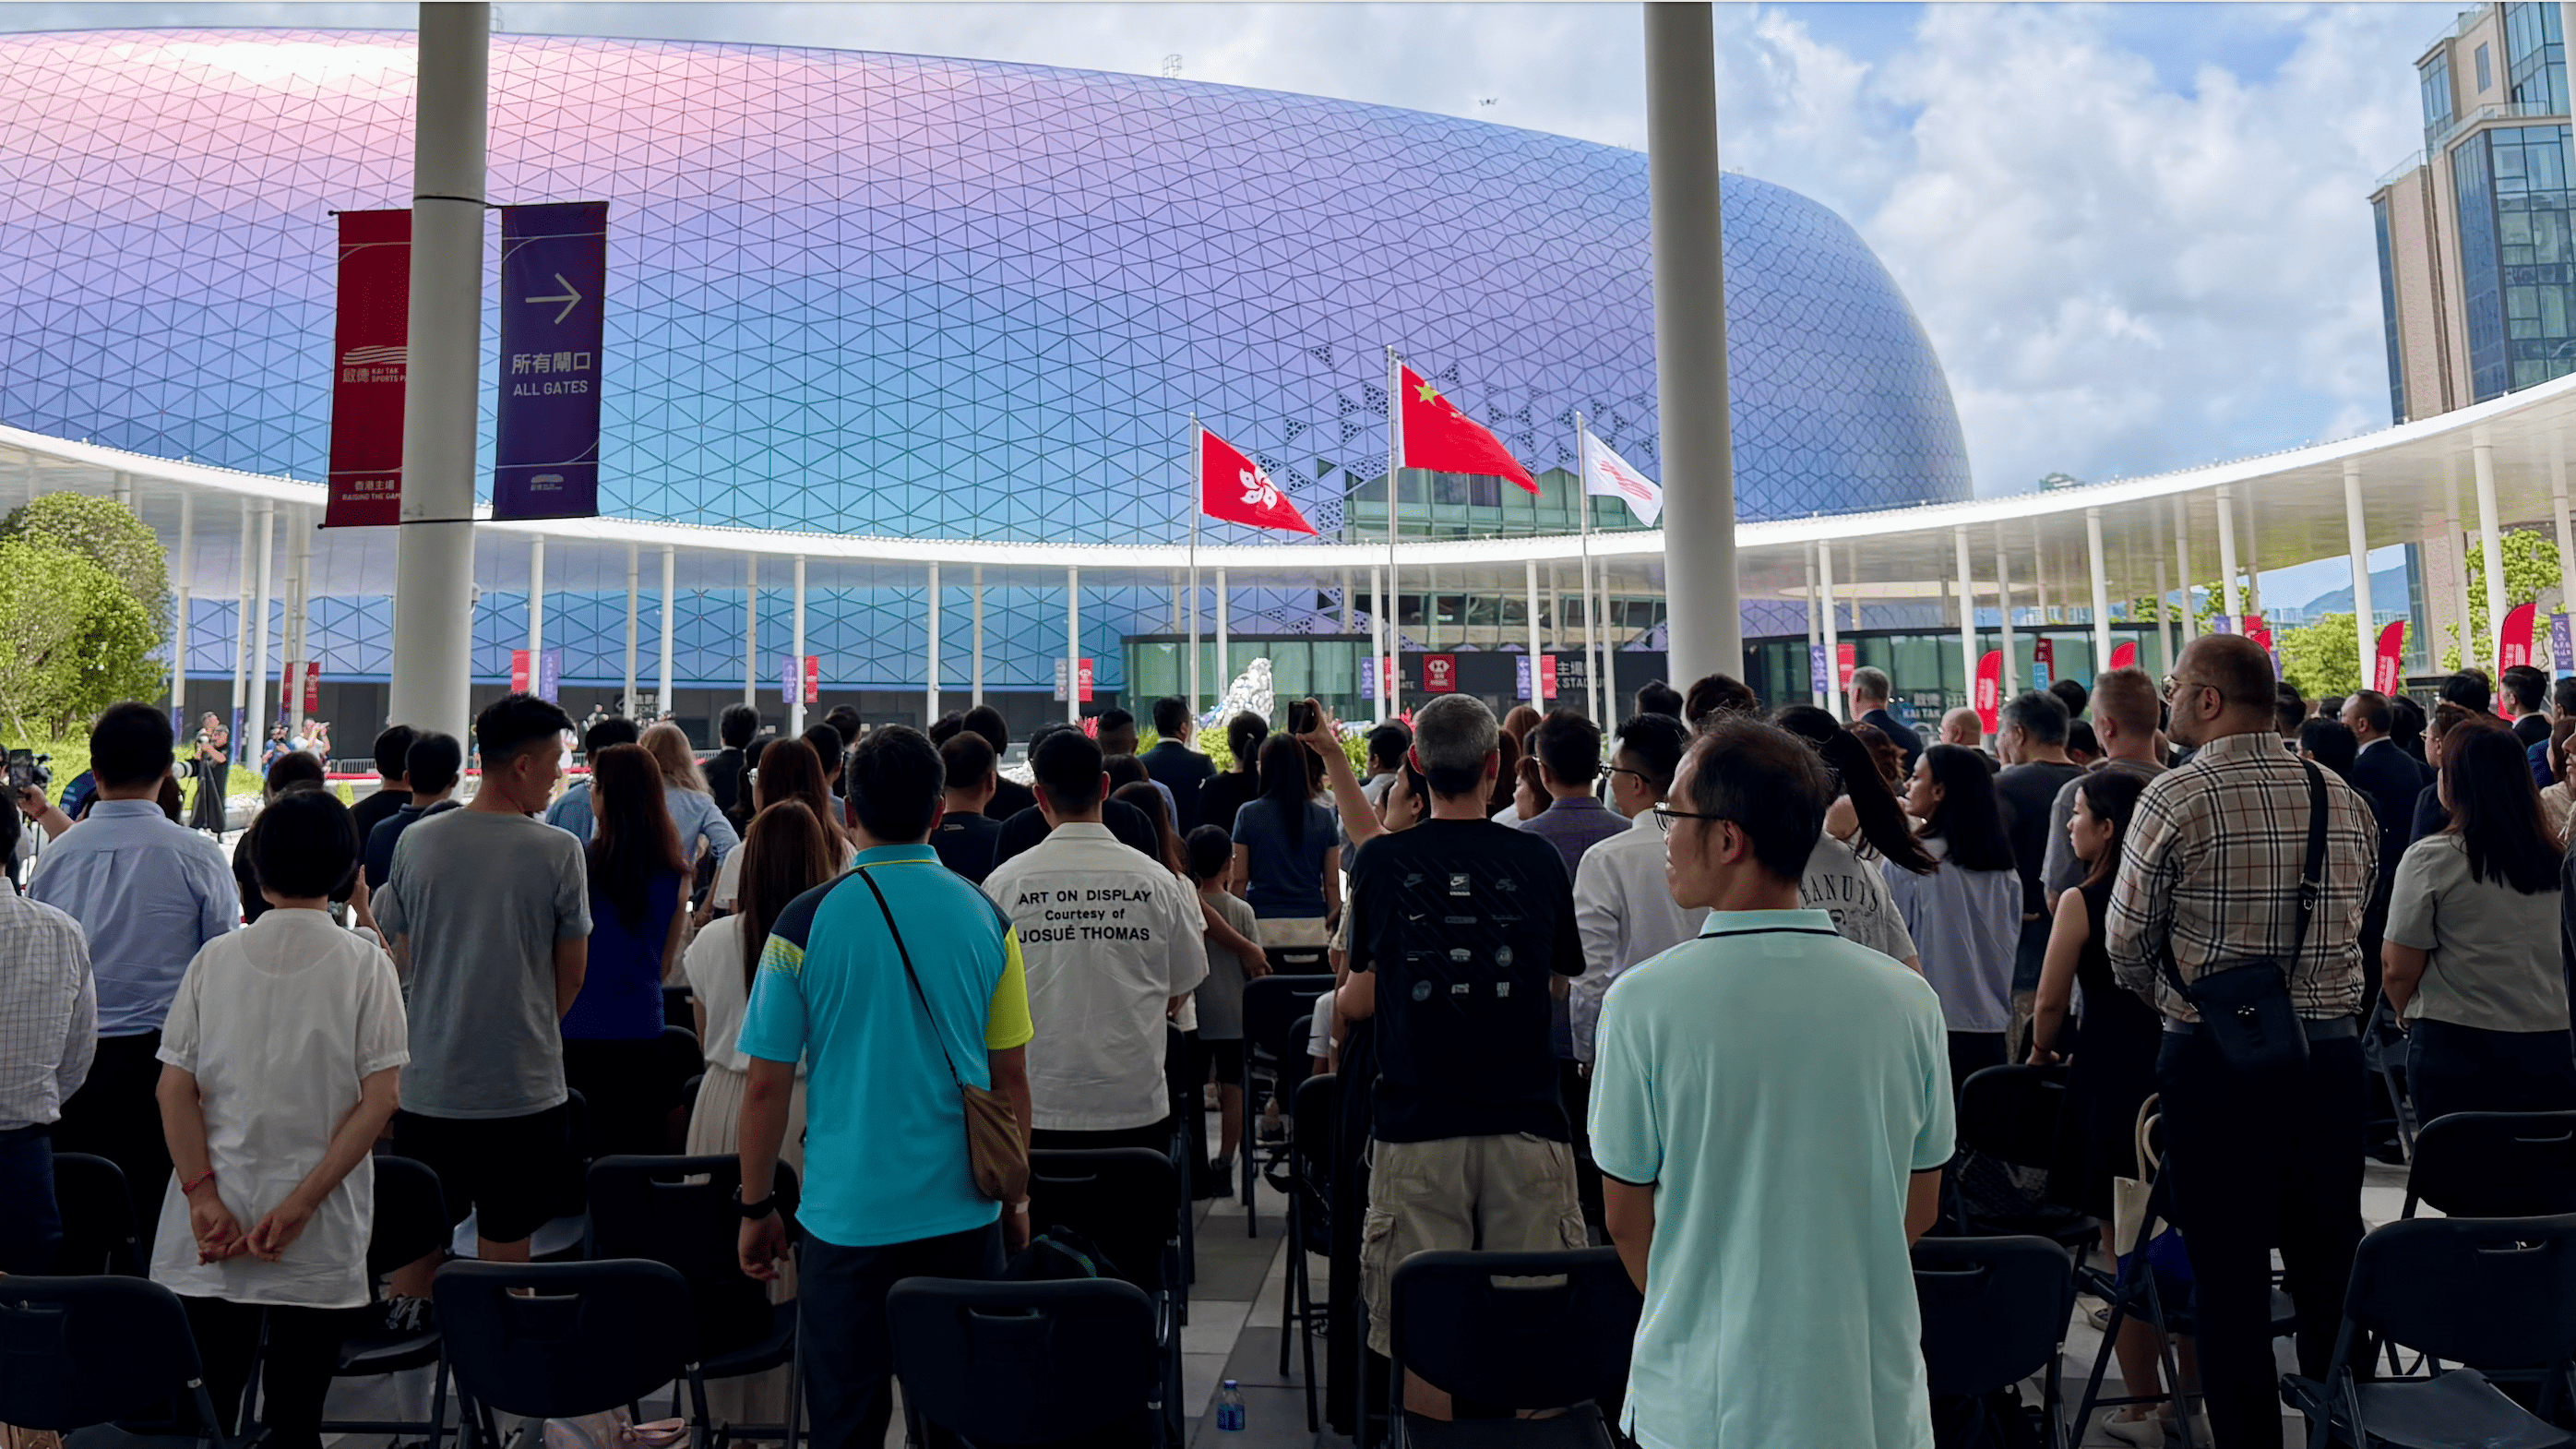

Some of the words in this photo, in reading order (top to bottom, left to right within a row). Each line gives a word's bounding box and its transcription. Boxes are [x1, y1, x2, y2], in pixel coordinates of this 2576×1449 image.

[512, 353, 590, 375] 所有閘口
[514, 383, 540, 396] ALL
[543, 380, 589, 395] GATES
[1019, 892, 1049, 904] ART
[1056, 891, 1078, 902] ON
[1087, 889, 1151, 903] DISPLAY
[1044, 908, 1105, 921] Courtesy
[1112, 908, 1125, 919] of
[1019, 925, 1076, 944] JOSUÉ
[1080, 927, 1151, 941] THOMAS
